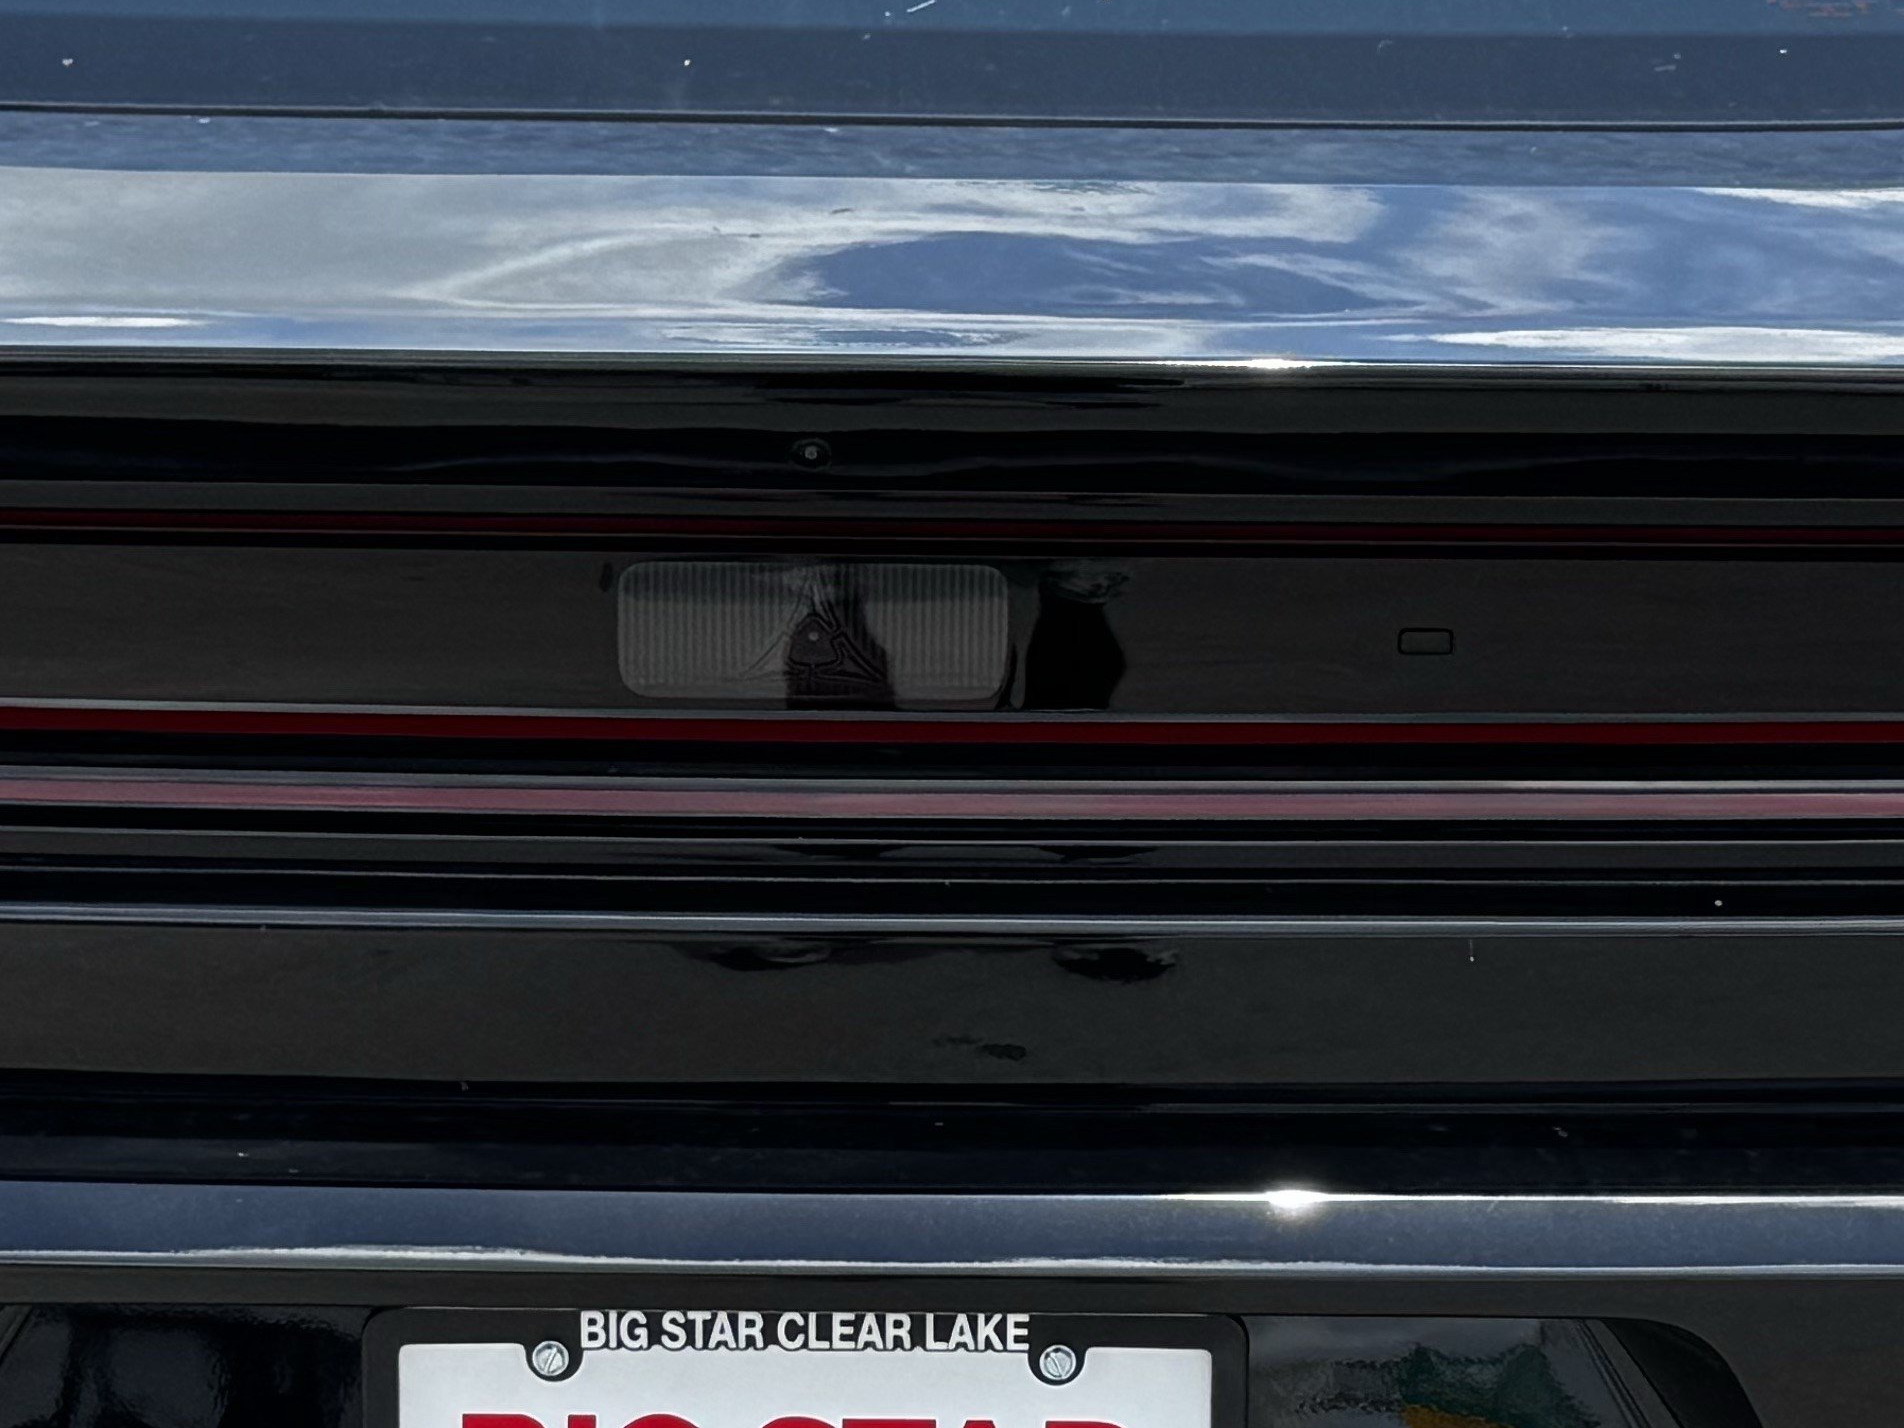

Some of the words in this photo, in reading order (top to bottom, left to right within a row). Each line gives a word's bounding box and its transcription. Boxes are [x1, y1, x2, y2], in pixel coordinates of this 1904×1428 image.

[580, 1309, 648, 1349] BIG
[660, 1310, 765, 1350] STAR
[777, 1311, 912, 1351] CLEAR
[924, 1312, 1031, 1351] LAKE
